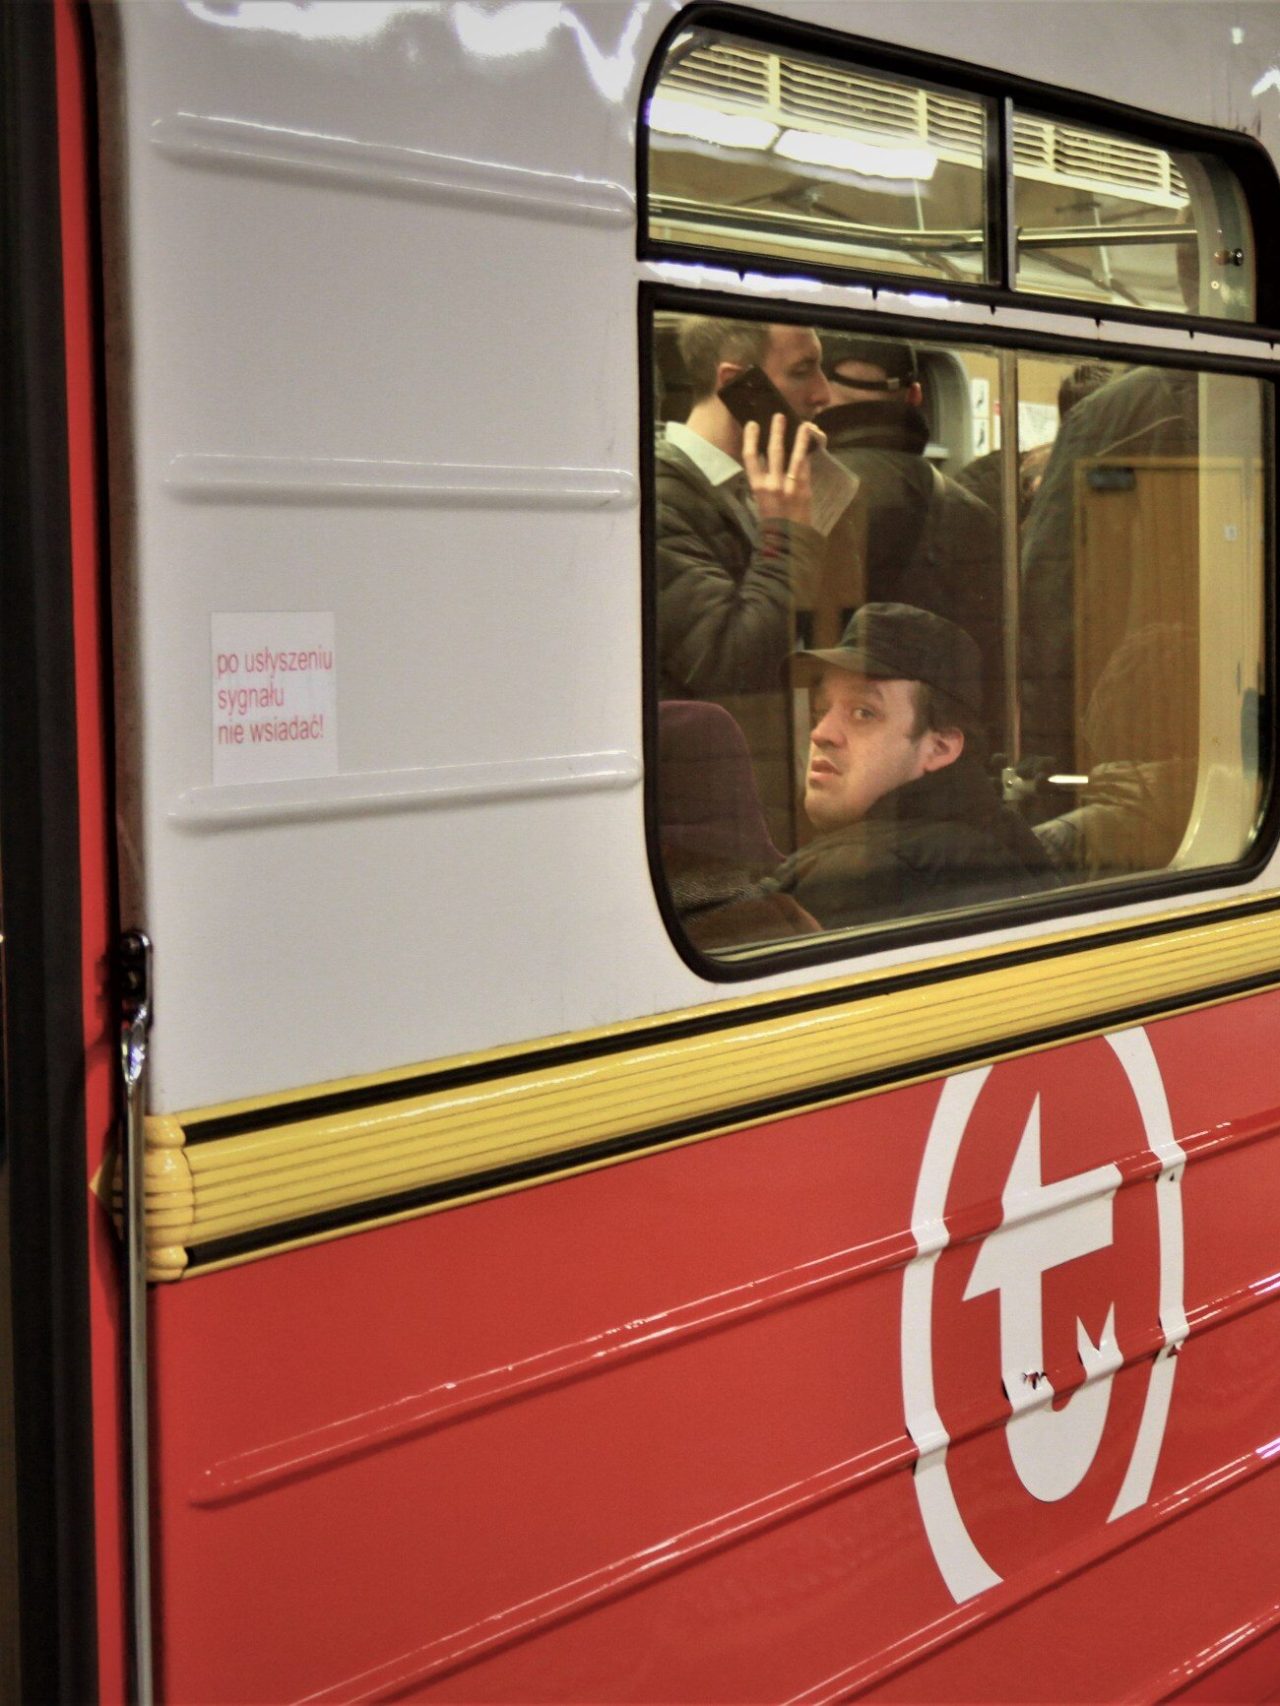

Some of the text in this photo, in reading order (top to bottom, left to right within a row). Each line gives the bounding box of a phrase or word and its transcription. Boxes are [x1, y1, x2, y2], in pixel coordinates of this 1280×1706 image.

[217, 644, 333, 679] po usłyszeniu
[217, 681, 285, 716] sygnału
[218, 713, 324, 744] nie wsiadać!
